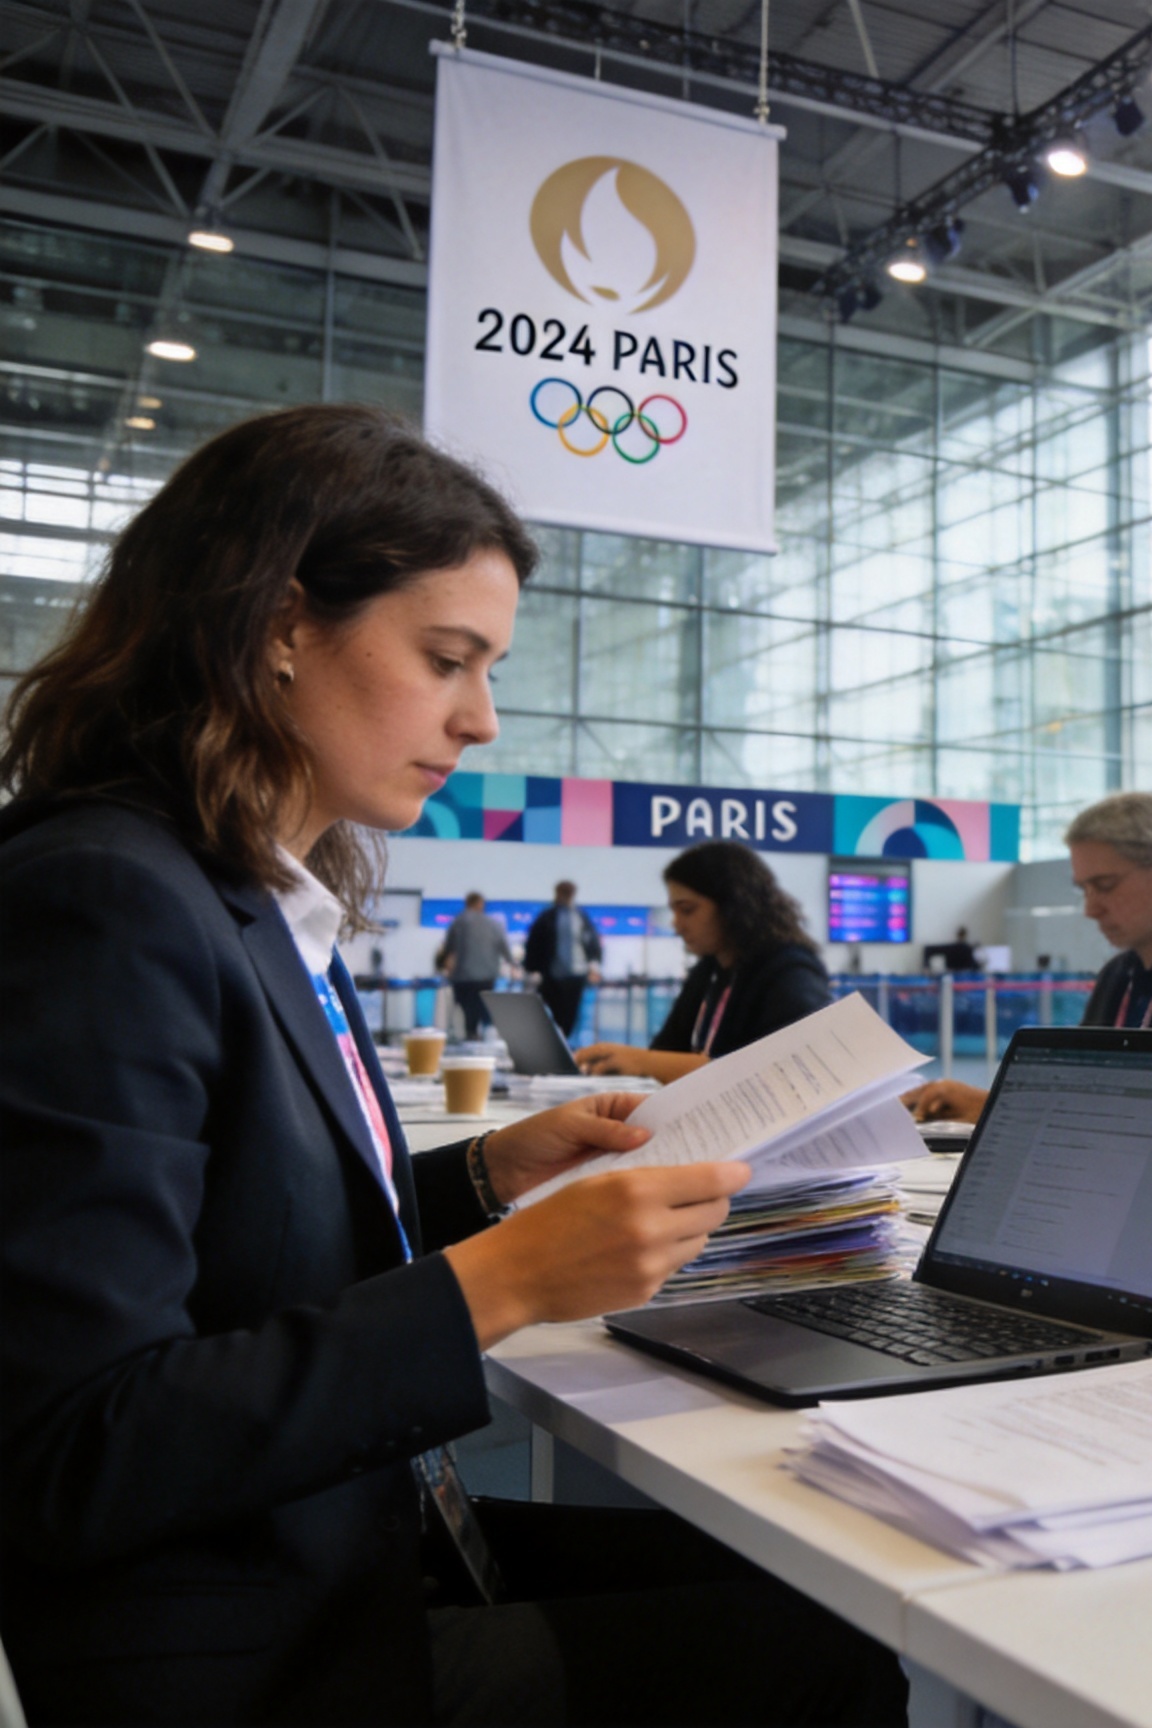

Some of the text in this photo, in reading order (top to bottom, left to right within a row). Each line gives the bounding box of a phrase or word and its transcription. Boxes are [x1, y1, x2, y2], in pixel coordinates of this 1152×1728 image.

[474, 308, 739, 389] 2024 PARIS
[651, 795, 798, 842] PARIS
